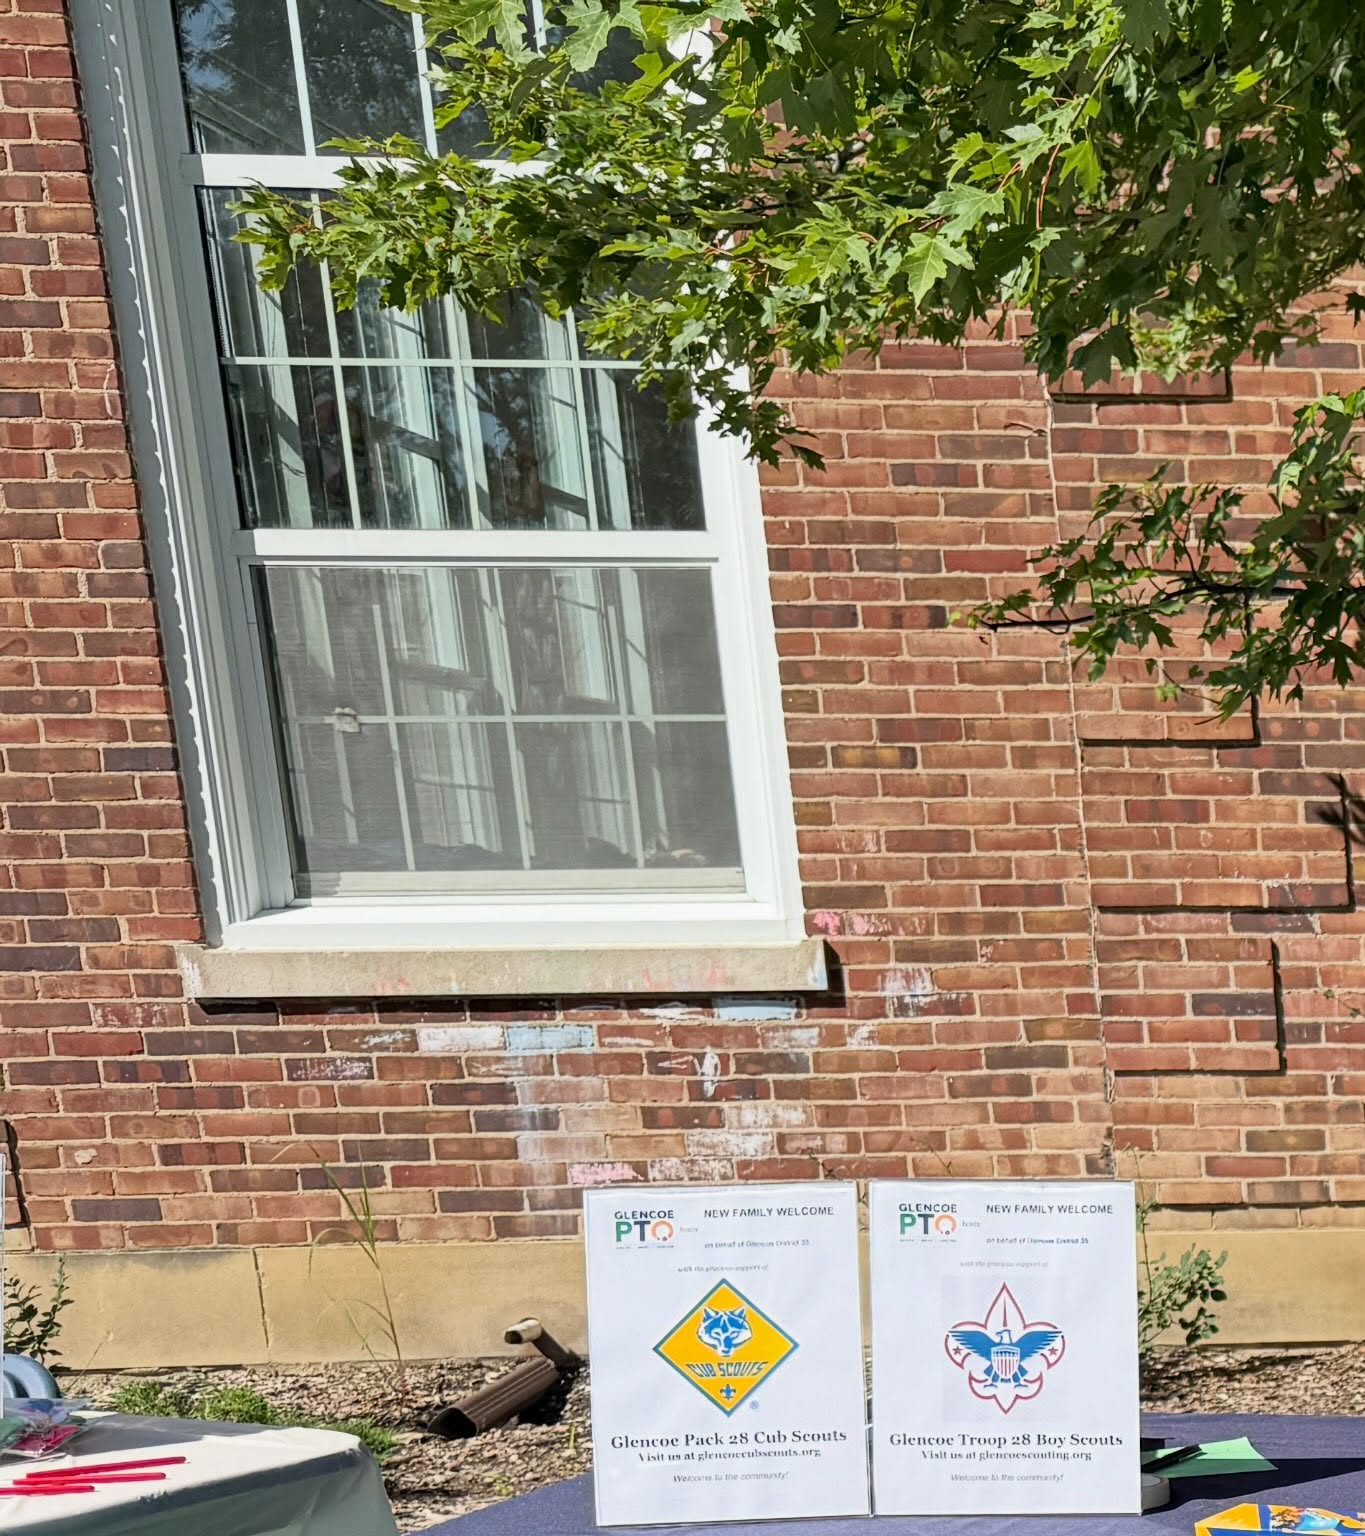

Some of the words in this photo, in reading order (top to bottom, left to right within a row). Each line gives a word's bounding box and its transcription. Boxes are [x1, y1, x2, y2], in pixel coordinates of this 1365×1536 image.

[704, 1209, 730, 1218] NEW
[732, 1208, 773, 1217] FAMILY
[776, 1206, 834, 1216] WELCOME
[899, 1203, 957, 1213] GLENCOE
[986, 1204, 1011, 1213] NEW
[1014, 1204, 1054, 1214] FAMILY
[1057, 1204, 1113, 1214] WELCOME
[614, 1210, 674, 1220] GLENCOE
[900, 1213, 957, 1235] PTO
[615, 1220, 674, 1242] PTO
[685, 1363, 717, 1377] CUB
[718, 1361, 769, 1377] SCOUTS
[611, 1435, 679, 1449] Glencoe
[685, 1432, 724, 1446] Pack
[729, 1432, 749, 1445] 28
[754, 1430, 787, 1444] Cub
[791, 1430, 847, 1443] Scouts
[890, 1433, 954, 1446] Glencoe
[958, 1433, 1007, 1449] Troop
[1011, 1433, 1031, 1445] 28
[1036, 1433, 1066, 1448] Boy
[1069, 1433, 1123, 1446] Scouts
[639, 1452, 664, 1462] Visit
[668, 1453, 681, 1461] us
[684, 1451, 695, 1460] at
[698, 1448, 821, 1461] glencoecubscouts.org
[922, 1450, 947, 1459] Visit
[965, 1451, 976, 1459] at
[979, 1449, 1092, 1461] glencoescouting.org
[673, 1474, 712, 1482] Welcome
